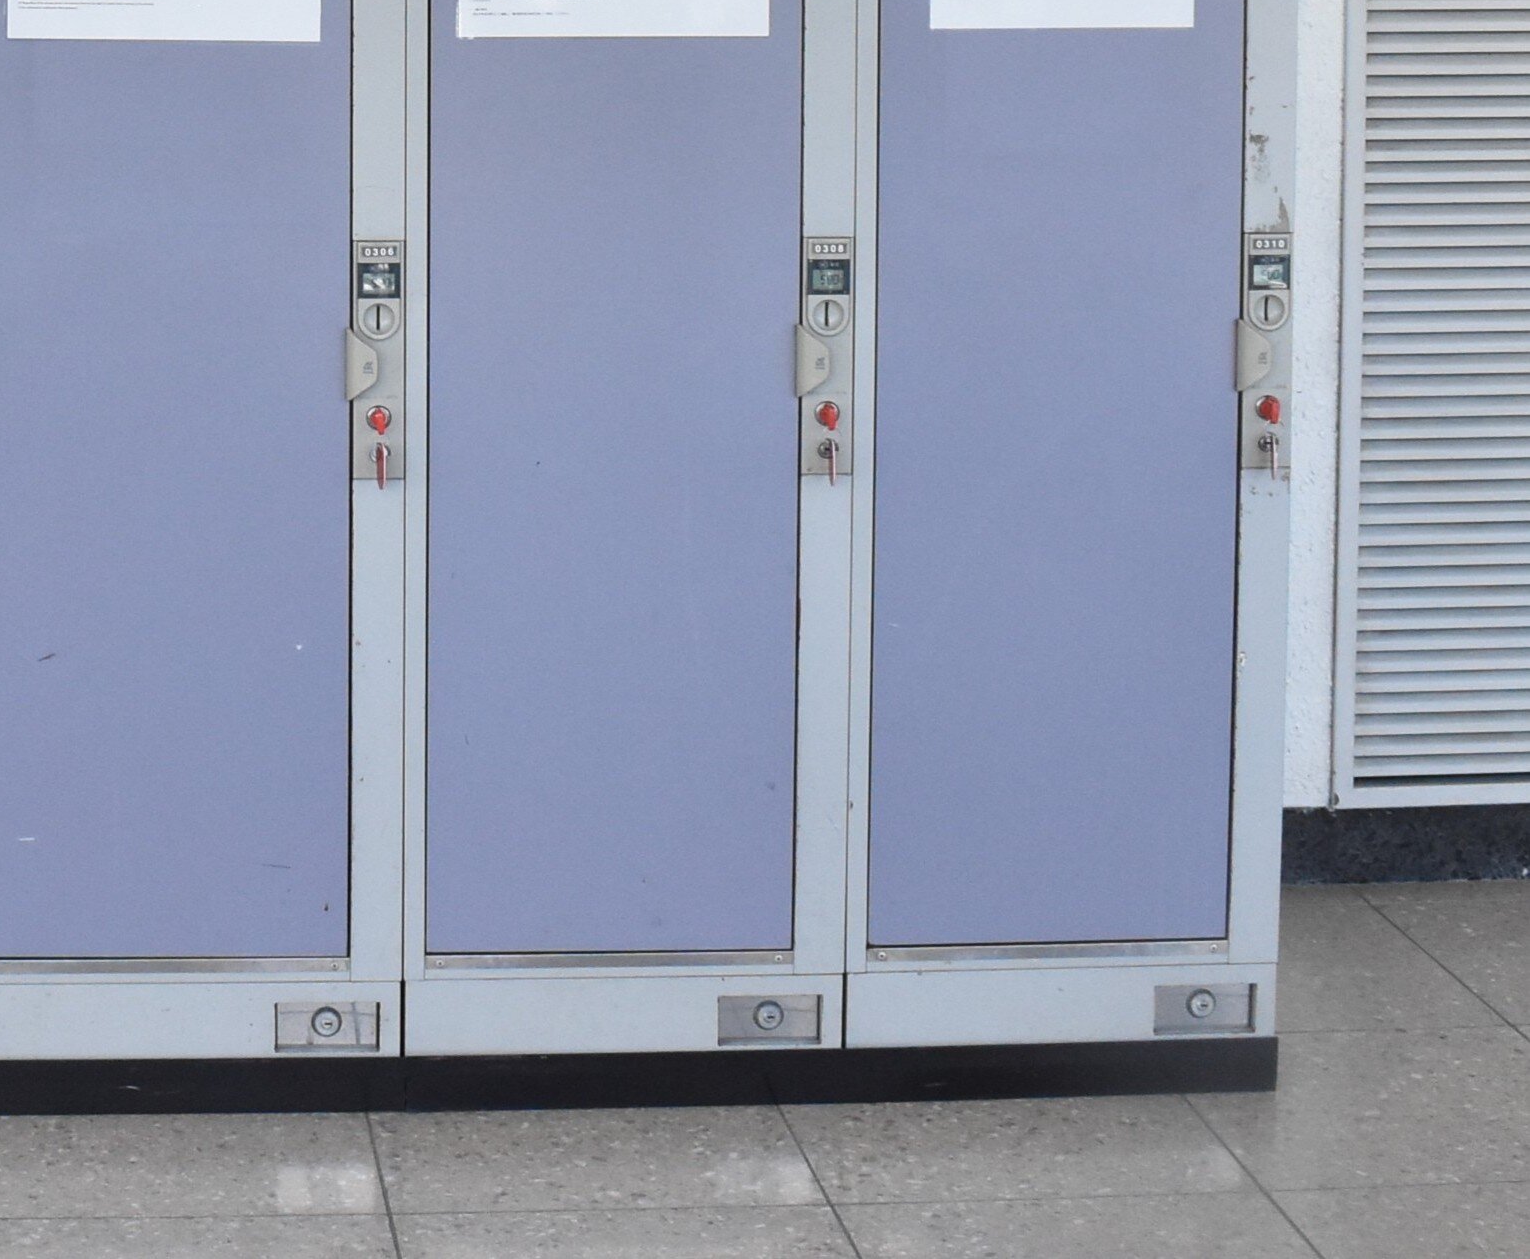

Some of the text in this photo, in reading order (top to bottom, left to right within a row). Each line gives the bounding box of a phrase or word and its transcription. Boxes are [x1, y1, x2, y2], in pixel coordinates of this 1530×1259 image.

[1255, 240, 1285, 248] 0310
[364, 248, 395, 256] 0306
[815, 244, 844, 253] 0308
